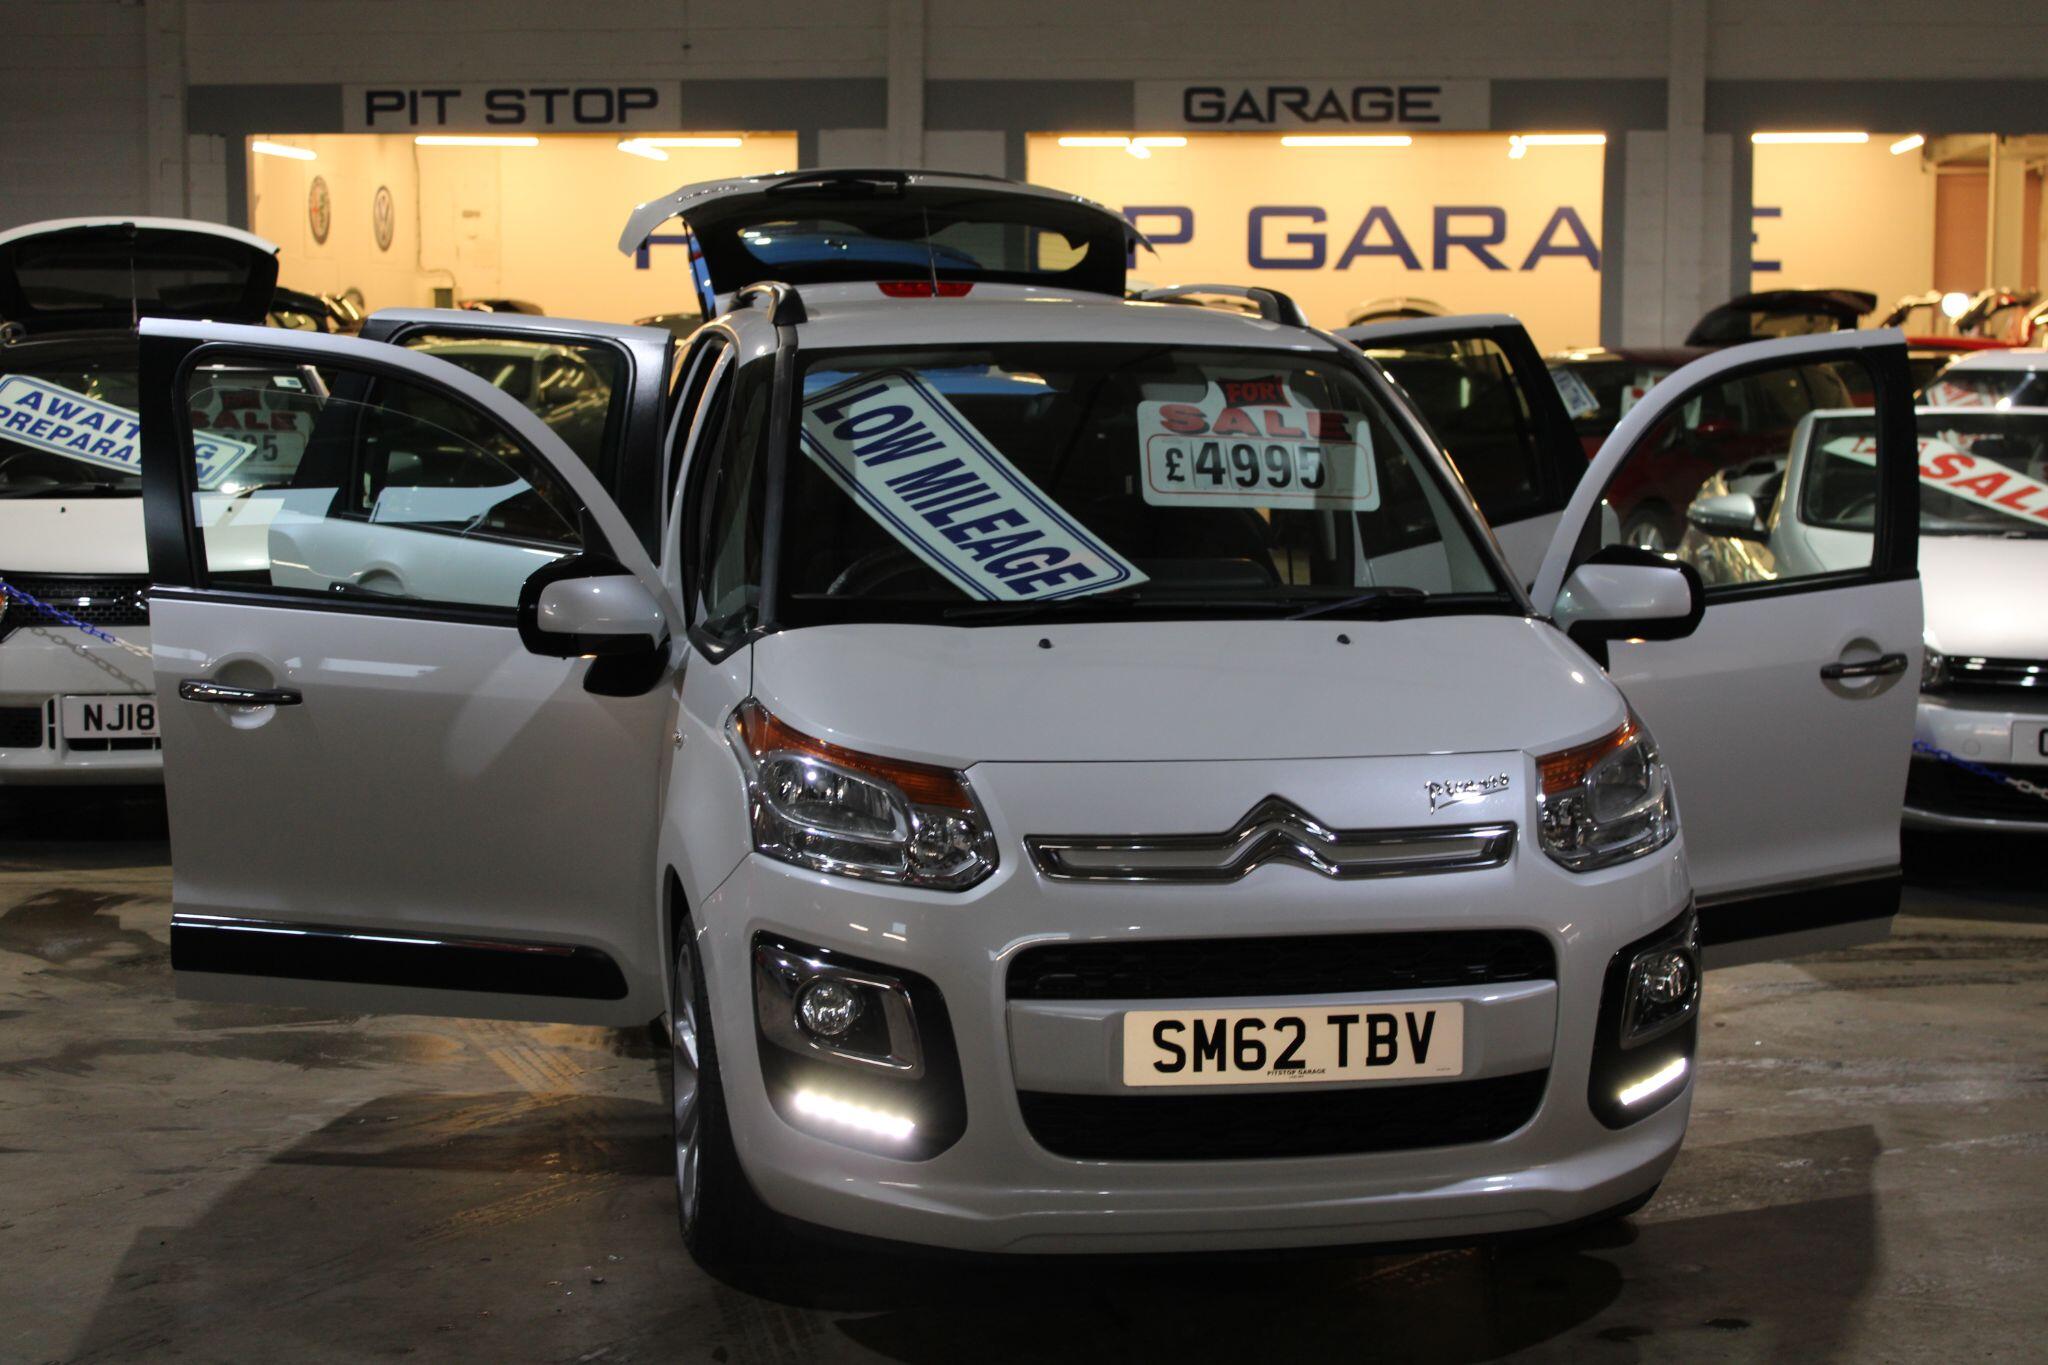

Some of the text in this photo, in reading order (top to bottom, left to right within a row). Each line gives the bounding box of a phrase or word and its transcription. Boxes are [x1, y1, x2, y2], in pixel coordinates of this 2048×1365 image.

[366, 87, 659, 126] PIT STOP
[1184, 86, 1441, 123] GARAGE
[1159, 404, 1353, 441] SALE
[1165, 441, 1326, 490] £4995
[812, 383, 1097, 596] LOW MILEAGE
[84, 704, 155, 731] NJ18
[1153, 1010, 1436, 1073] SM62 TBV
